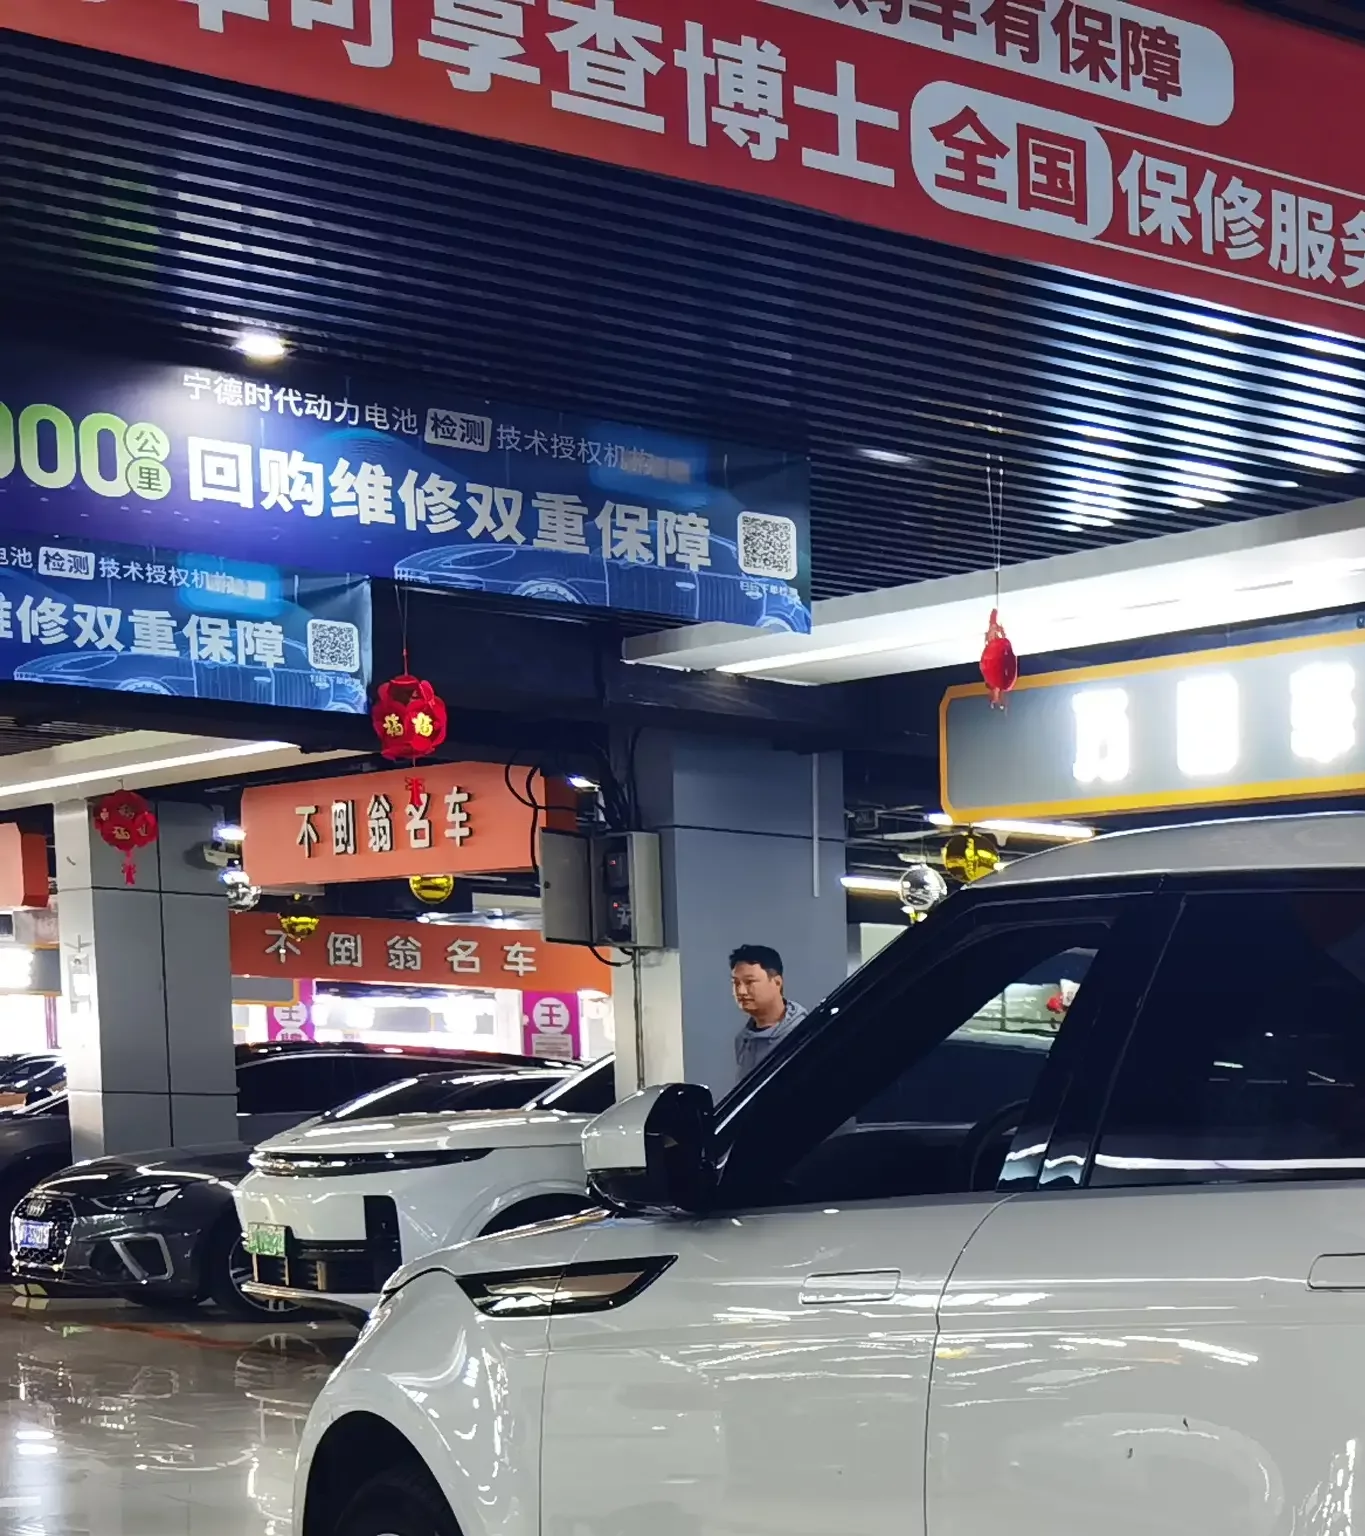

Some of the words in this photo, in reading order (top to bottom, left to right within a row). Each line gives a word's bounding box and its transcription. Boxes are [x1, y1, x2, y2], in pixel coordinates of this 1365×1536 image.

[836, 0, 1183, 103] 车有保障
[928, 105, 1090, 226] 全国
[183, 372, 419, 435] 宁德时代动力电池
[430, 412, 488, 446] 检测
[188, 436, 713, 572] 回购维修双重保障
[43, 550, 91, 576] 检测
[295, 786, 471, 858] 不倒翁名车
[264, 929, 538, 977] 不倒翁名车
